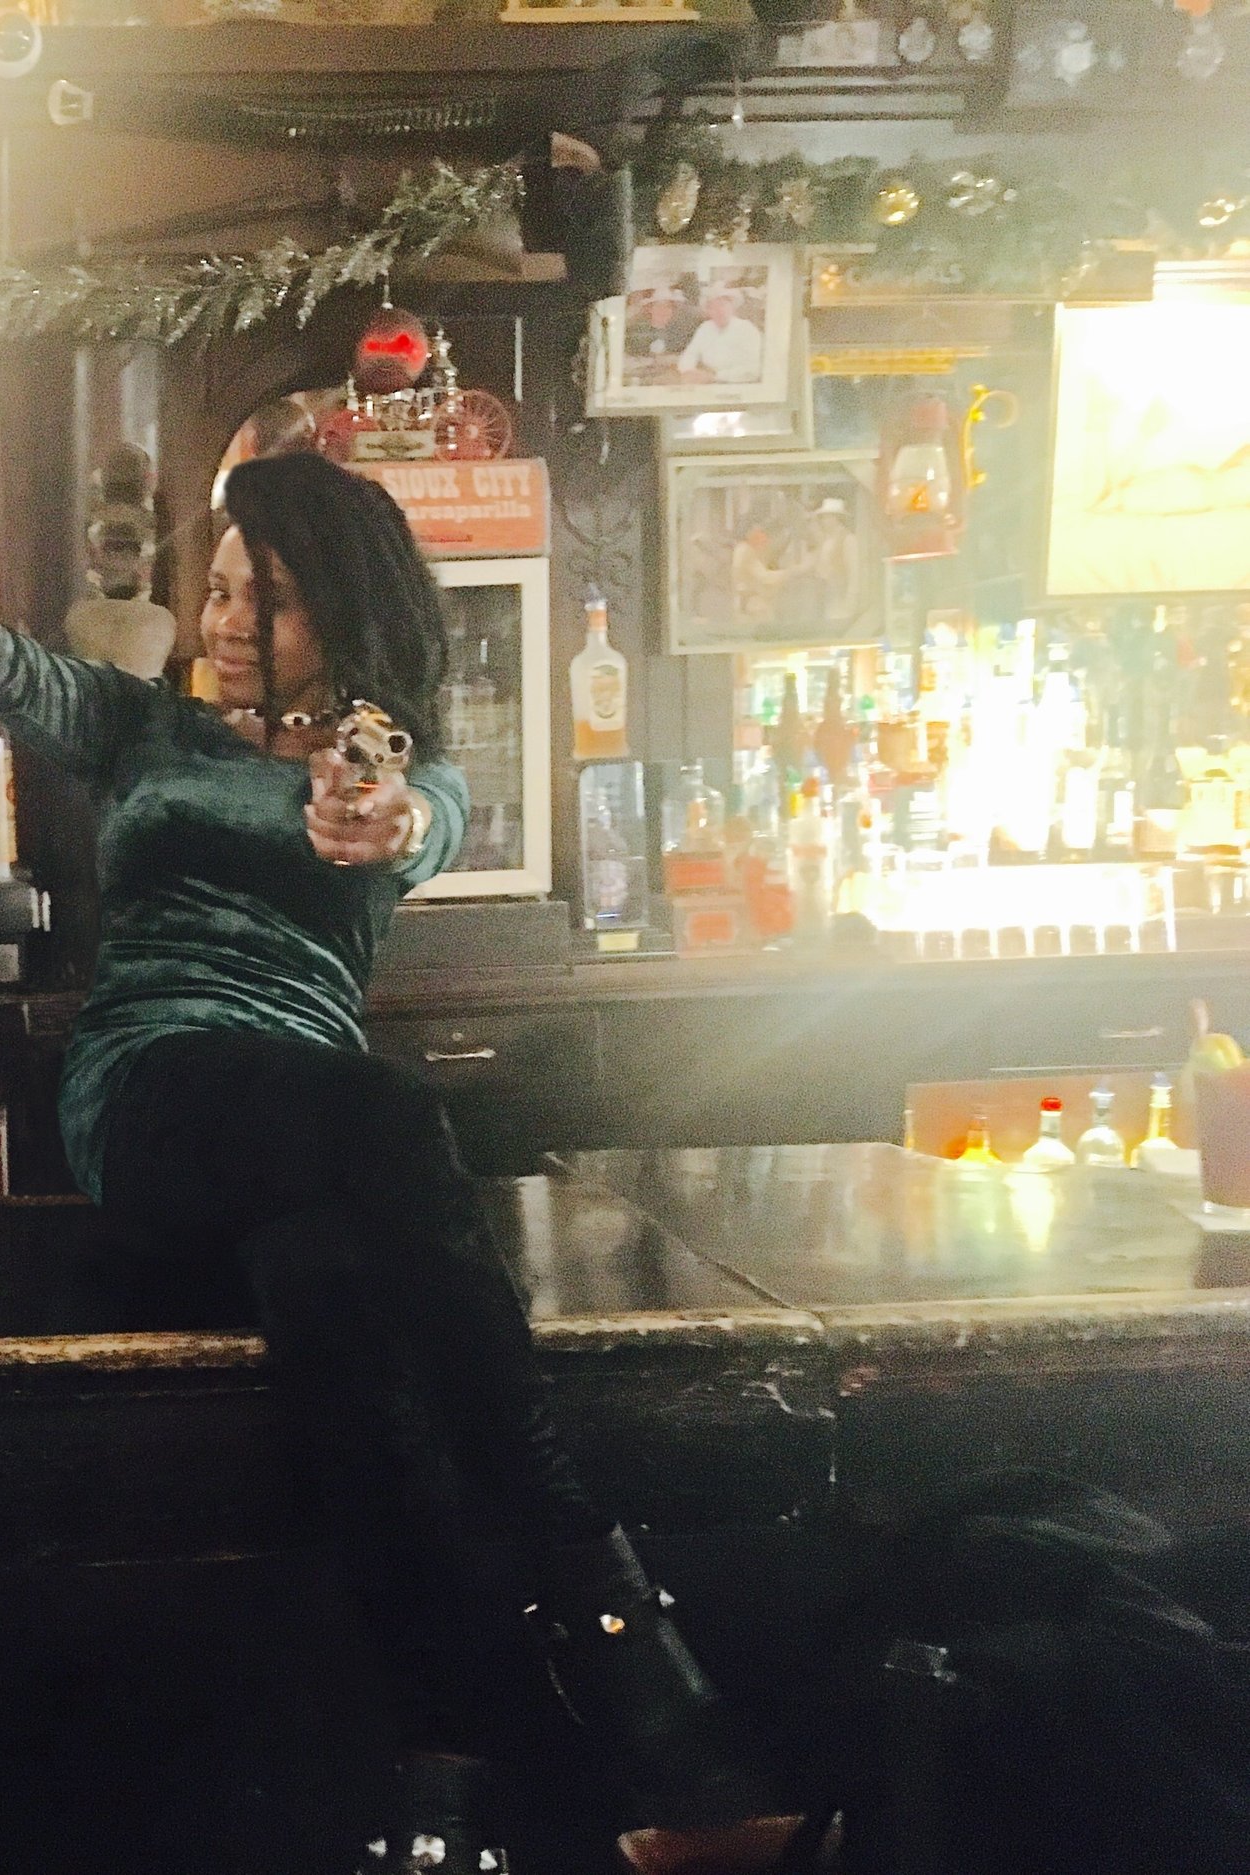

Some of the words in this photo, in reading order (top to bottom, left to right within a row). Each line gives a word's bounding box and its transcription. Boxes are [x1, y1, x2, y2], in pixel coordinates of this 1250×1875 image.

[382, 468, 460, 499] SIOUX
[473, 465, 531, 498] CITY
[406, 500, 532, 523] arsaparilla
